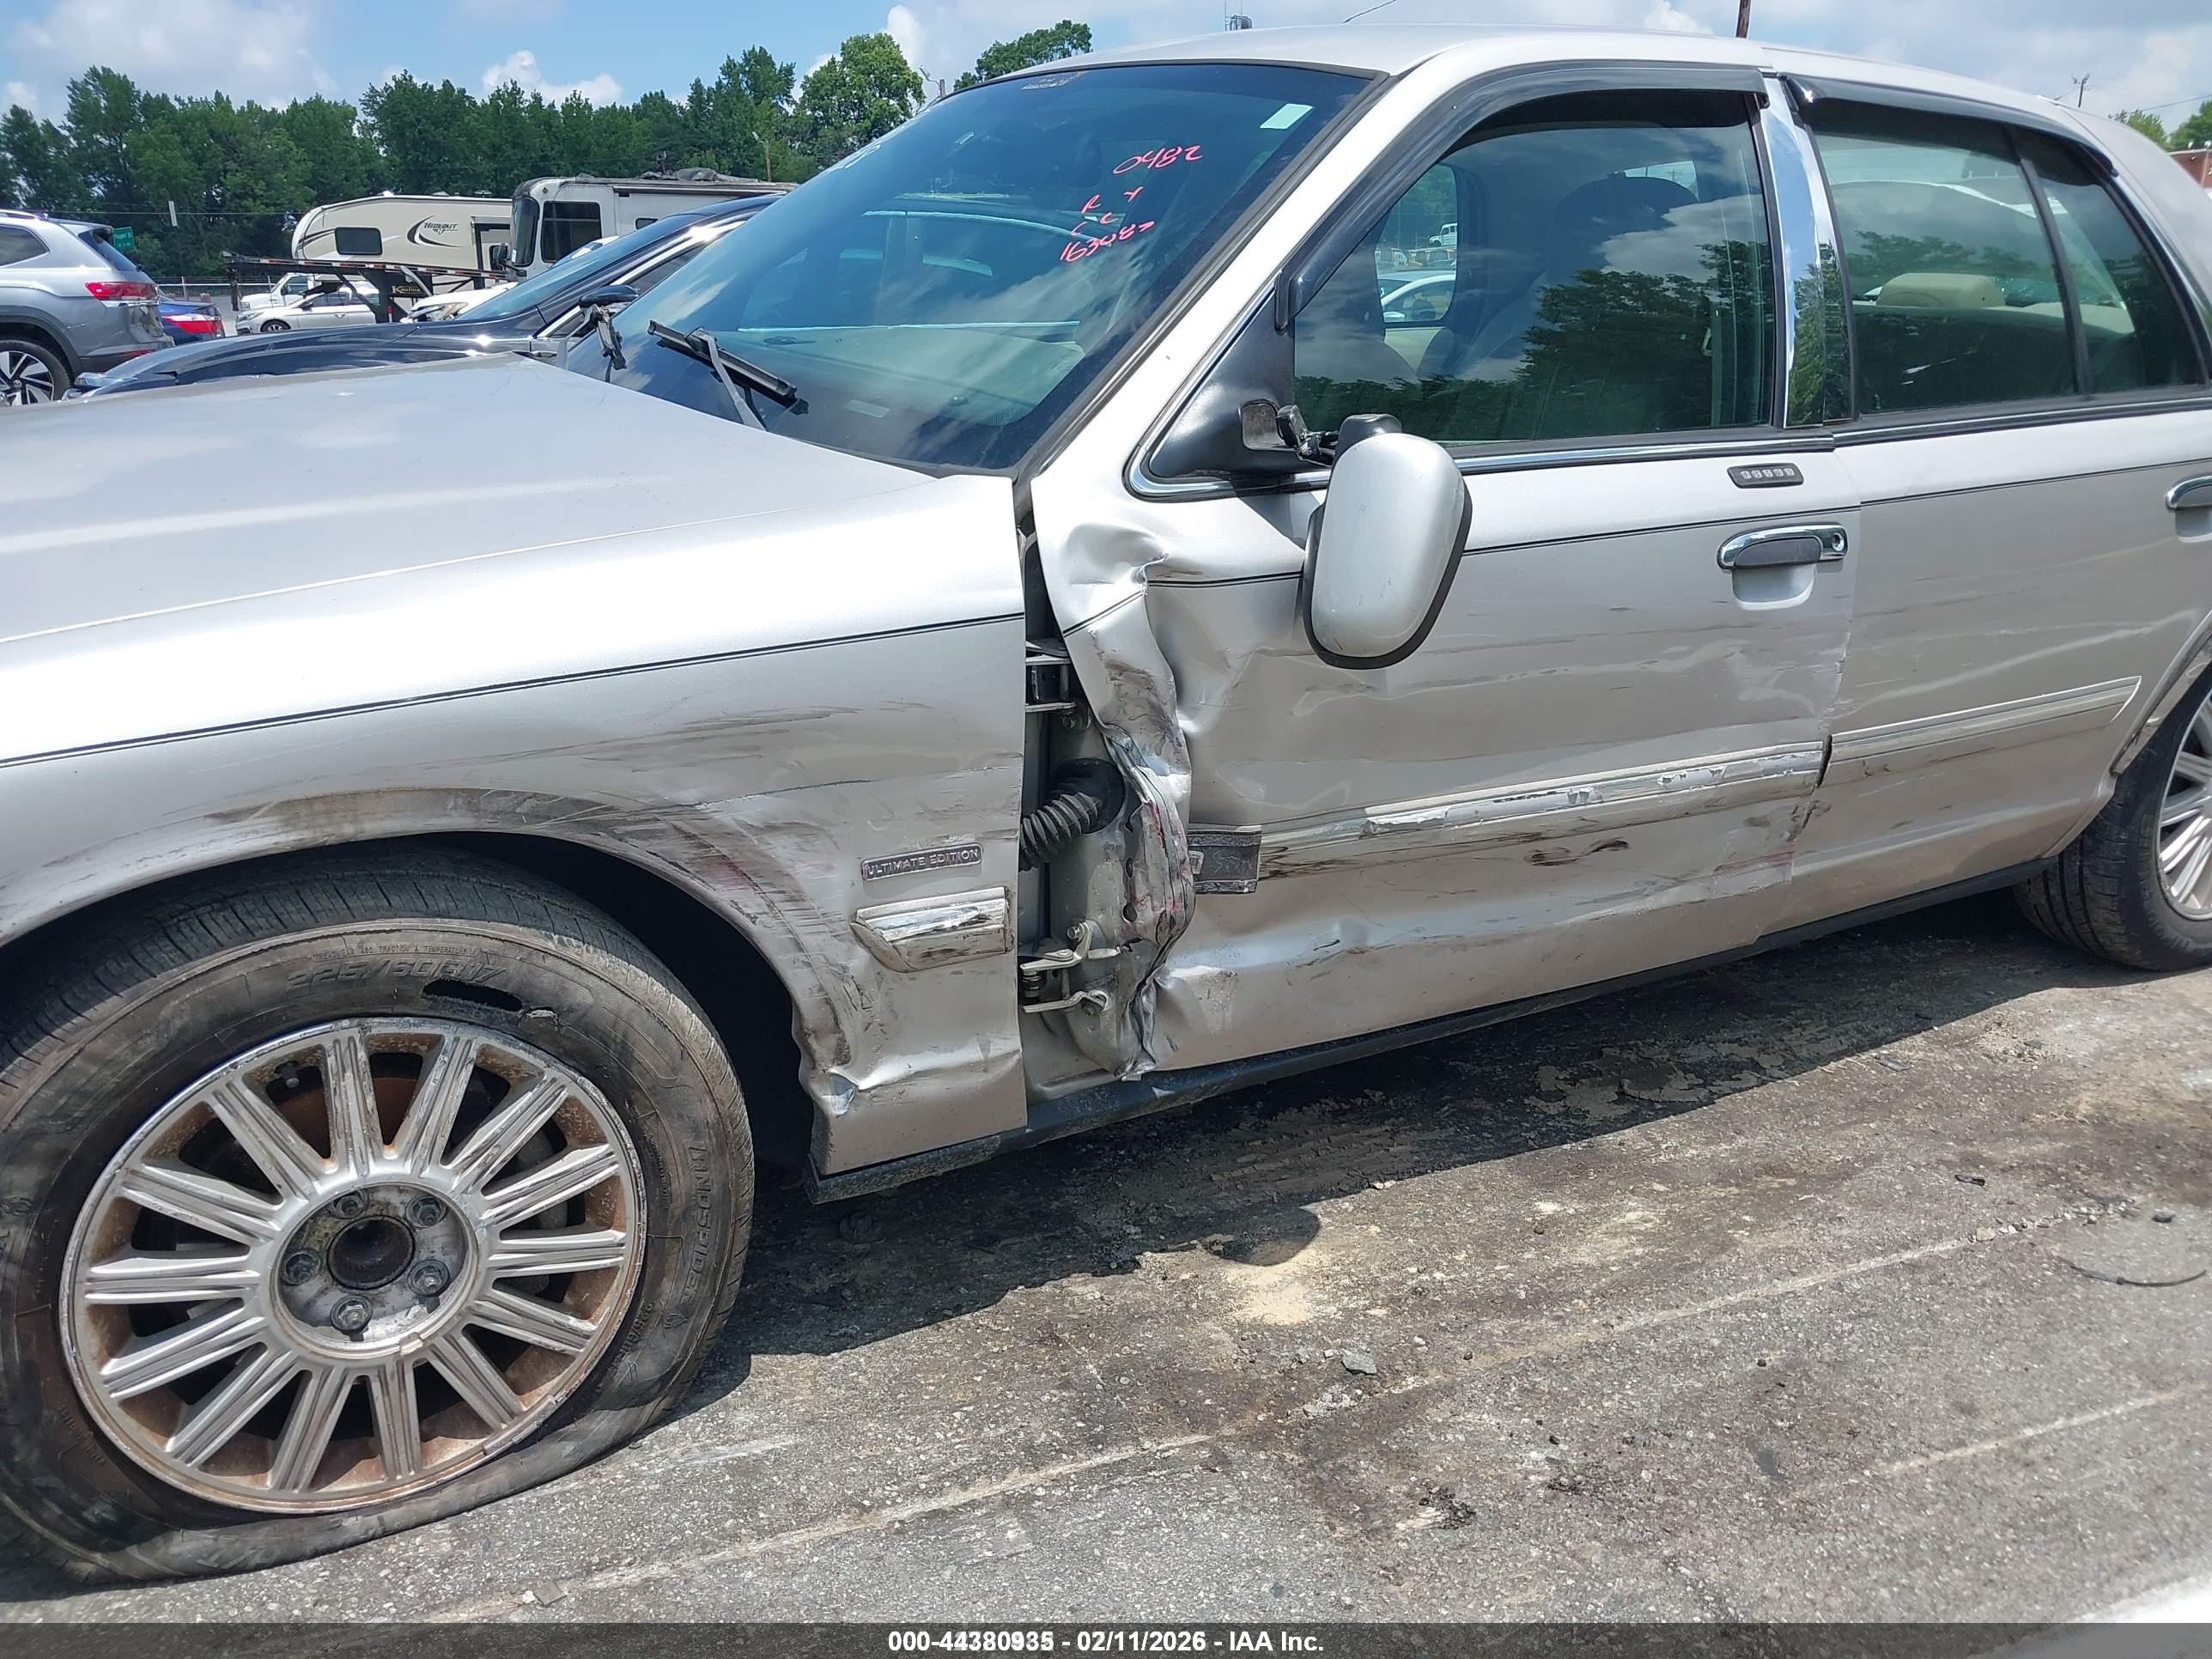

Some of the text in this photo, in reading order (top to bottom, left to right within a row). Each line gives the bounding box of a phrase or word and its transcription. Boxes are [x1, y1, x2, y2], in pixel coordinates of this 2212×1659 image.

[1113, 145, 1203, 174] 0482
[866, 848, 978, 875] ULTIMATE EDITION
[288, 957, 507, 988] 225/60R17
